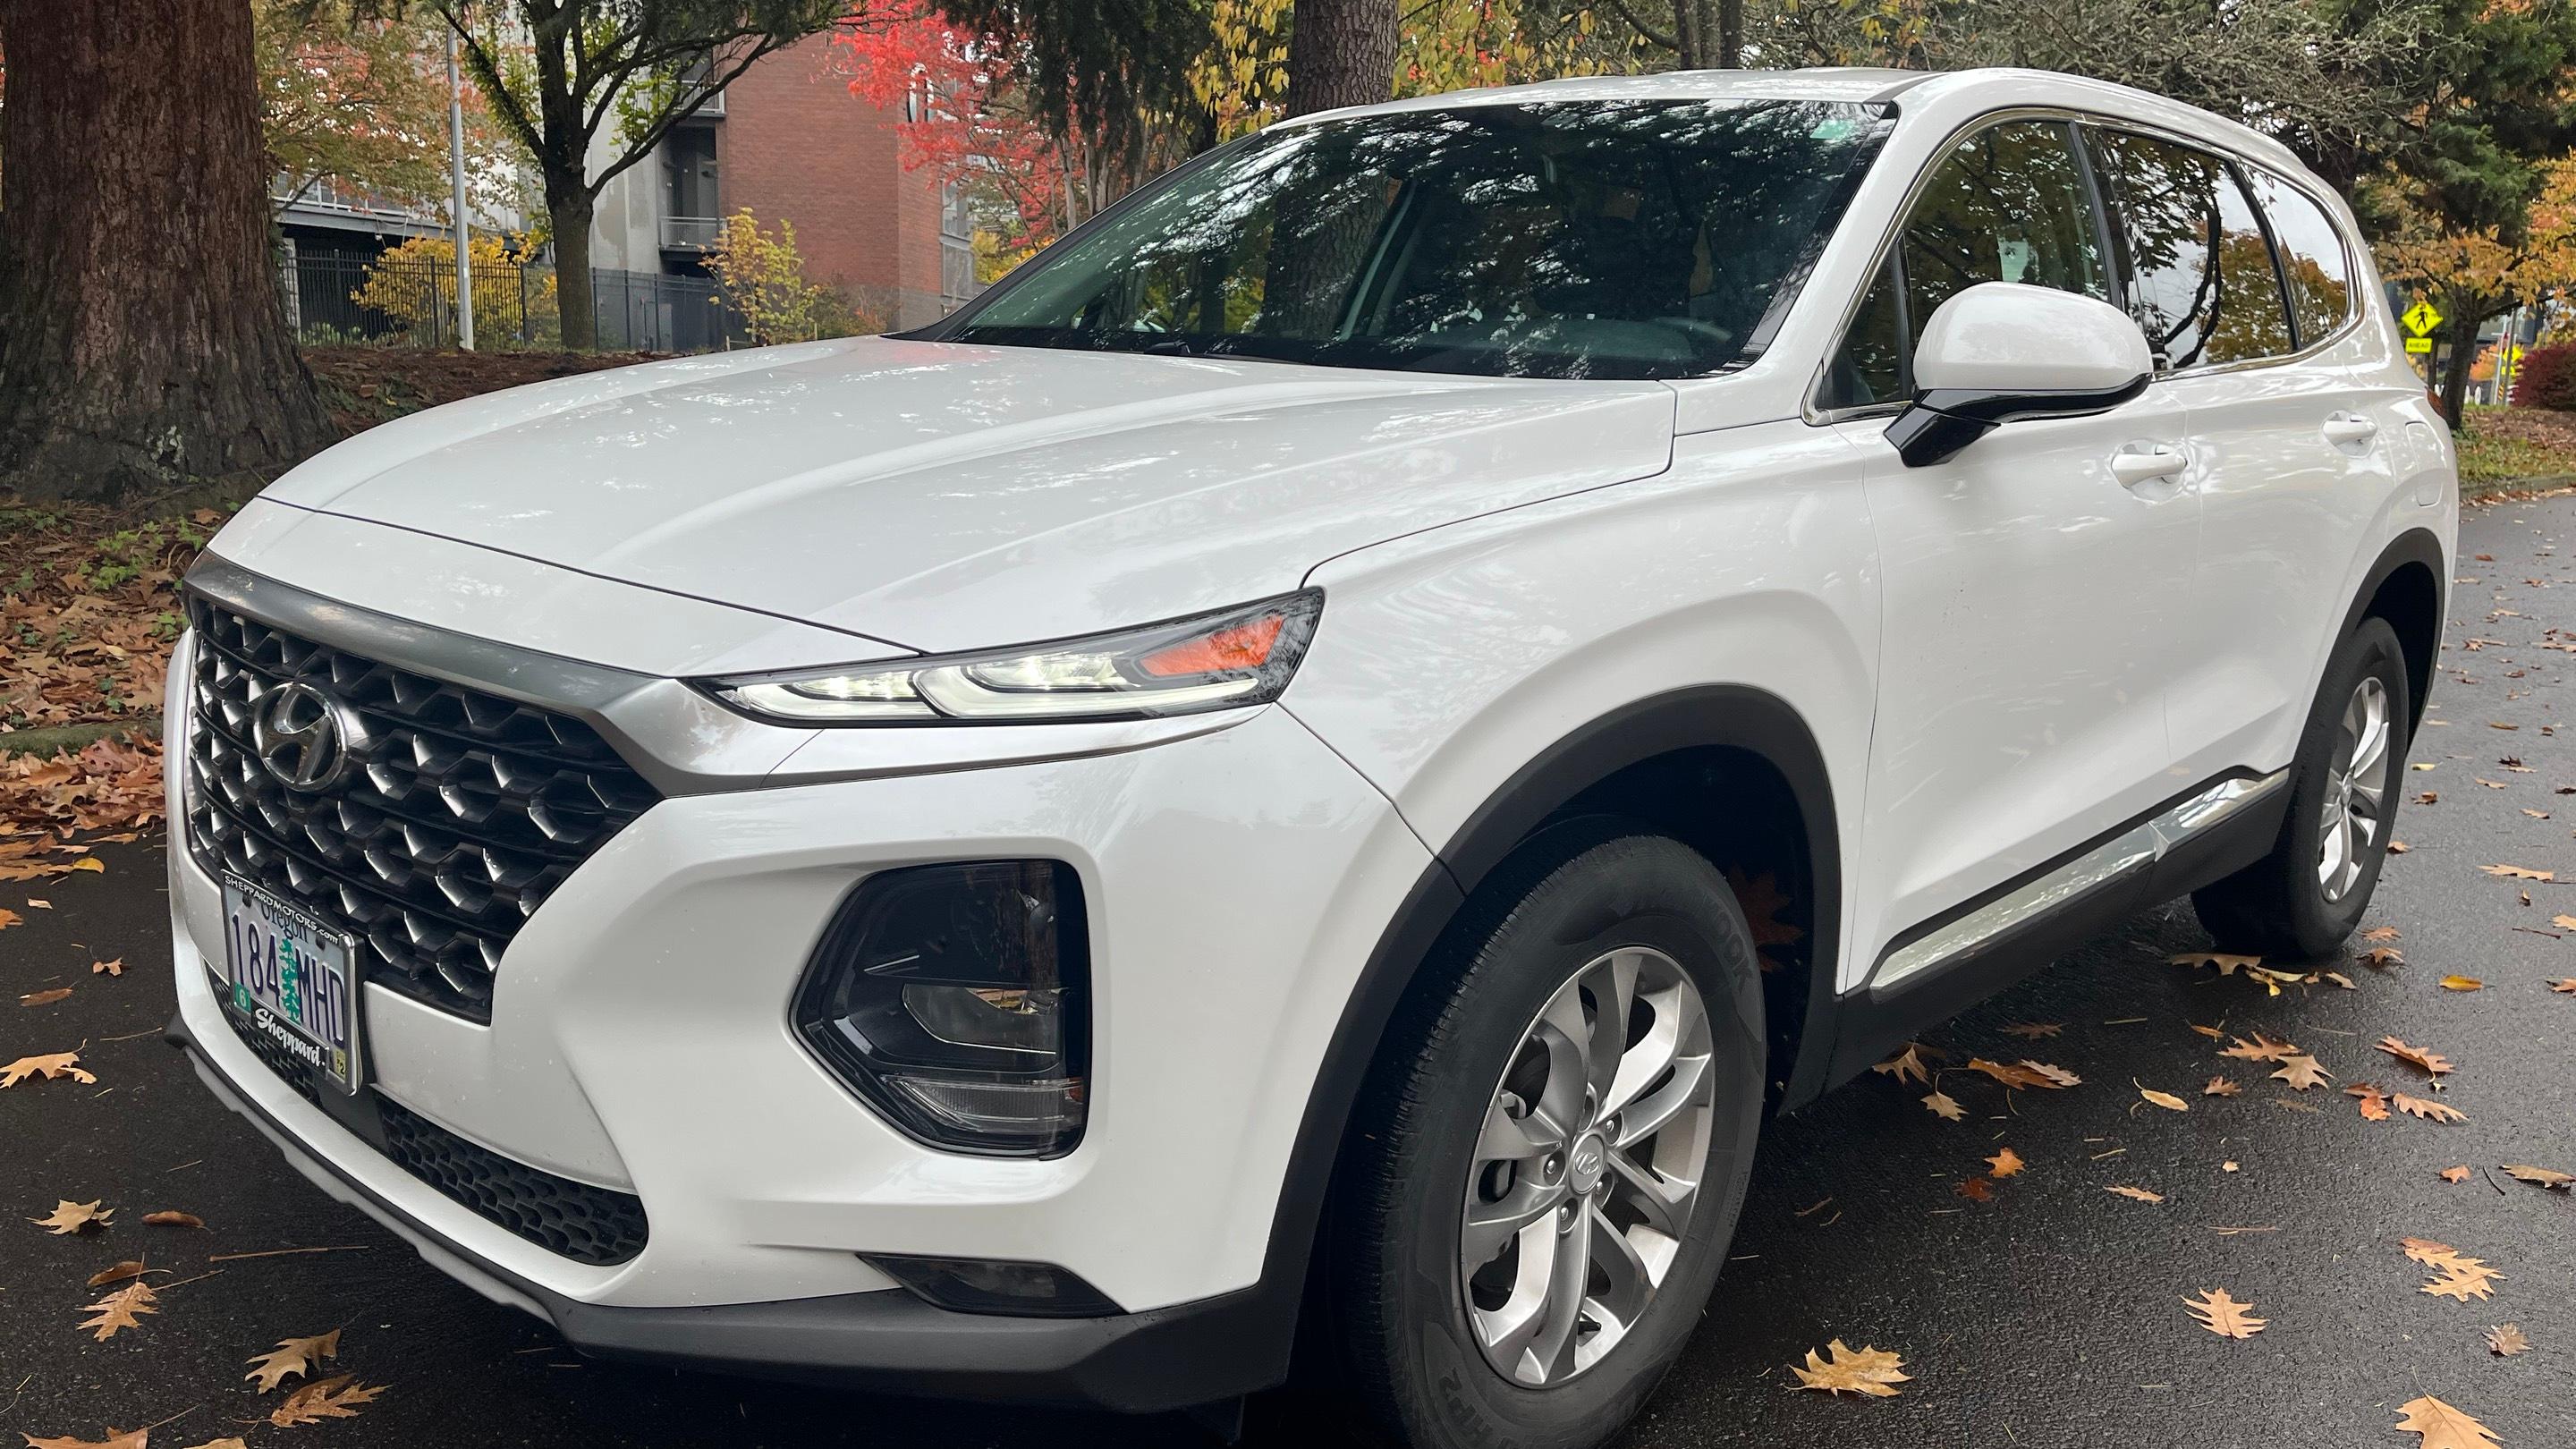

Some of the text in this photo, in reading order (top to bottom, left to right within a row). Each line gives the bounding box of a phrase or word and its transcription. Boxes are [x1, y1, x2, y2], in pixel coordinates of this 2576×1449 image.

[261, 903, 309, 945] Oregon
[233, 914, 344, 1050] 184 MHD
[238, 989, 247, 1007] 6
